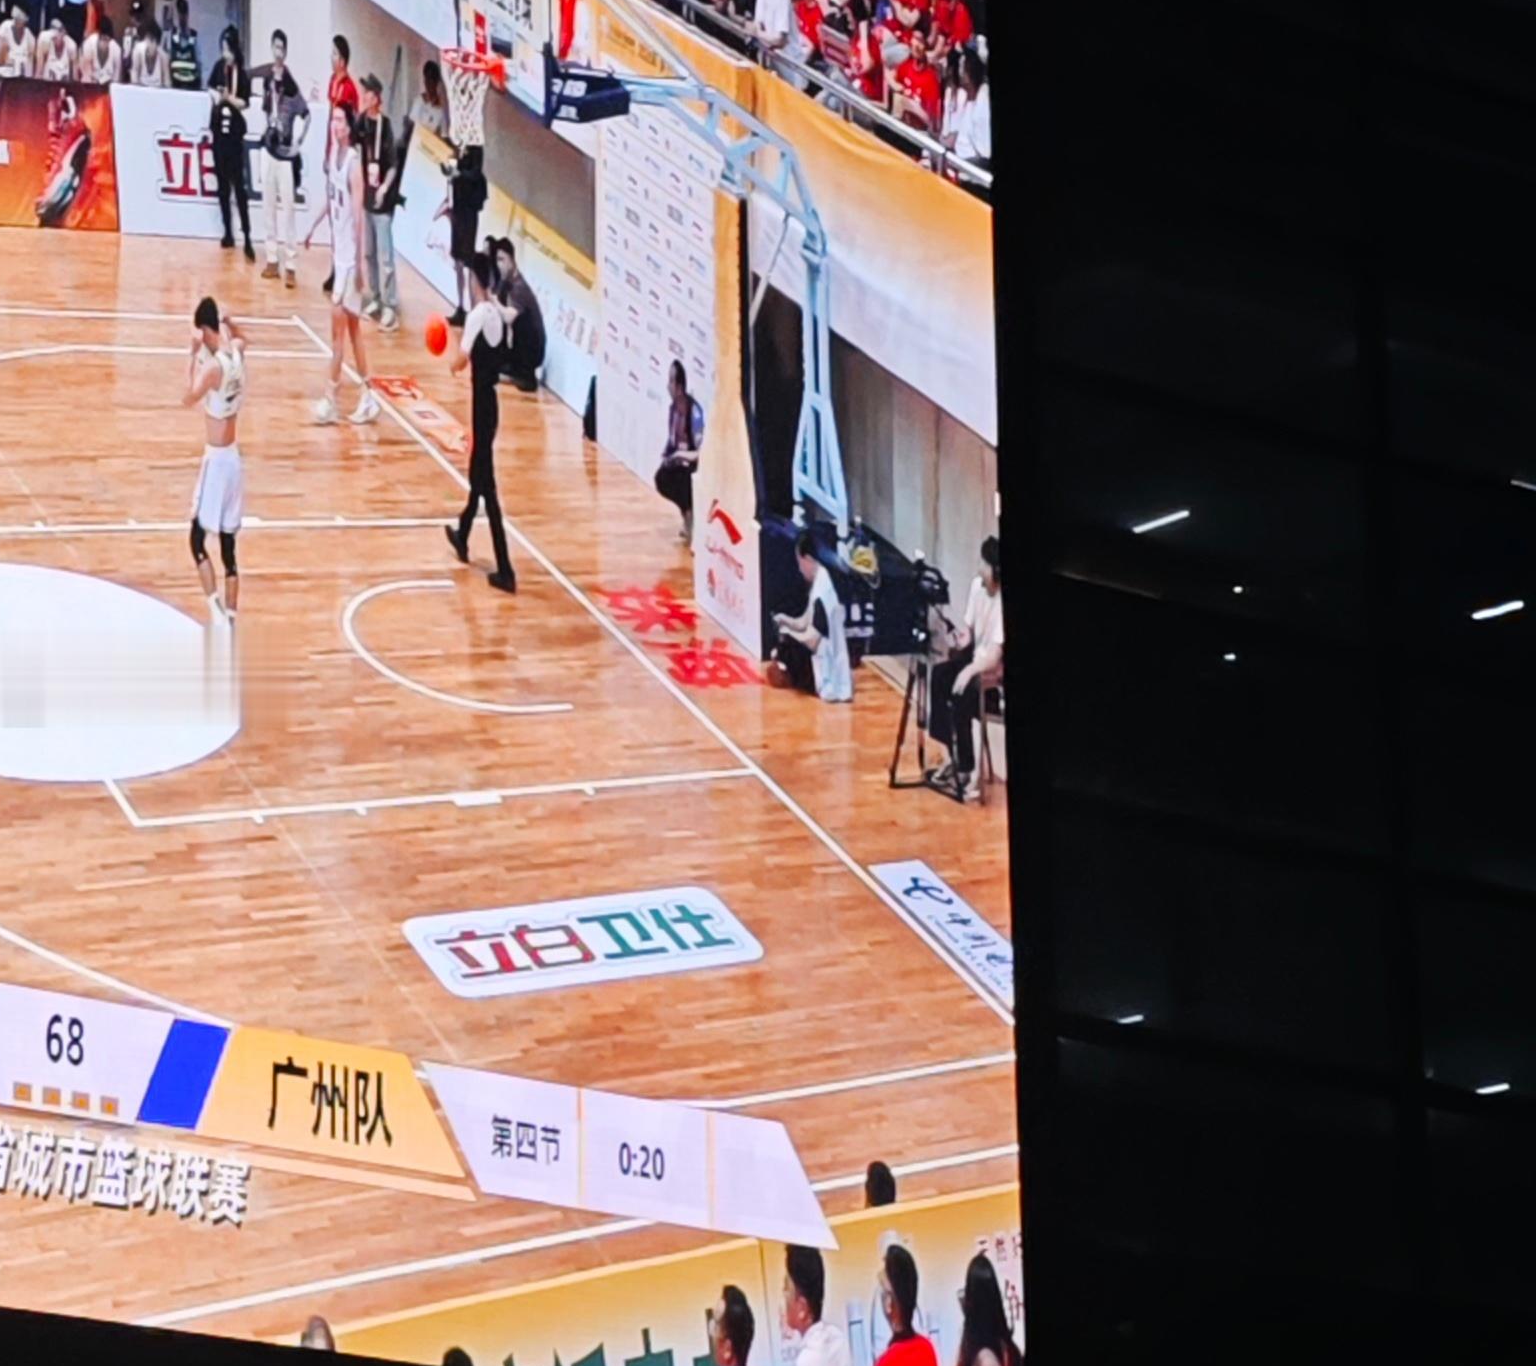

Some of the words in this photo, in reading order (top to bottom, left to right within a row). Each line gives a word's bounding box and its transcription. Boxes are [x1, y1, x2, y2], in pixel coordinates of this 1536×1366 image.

[433, 904, 735, 980] 立白卫仕
[45, 1013, 85, 1067] 68
[267, 1055, 393, 1148] 广州队
[490, 1113, 562, 1166] 第四节
[618, 1141, 665, 1182] 0:20
